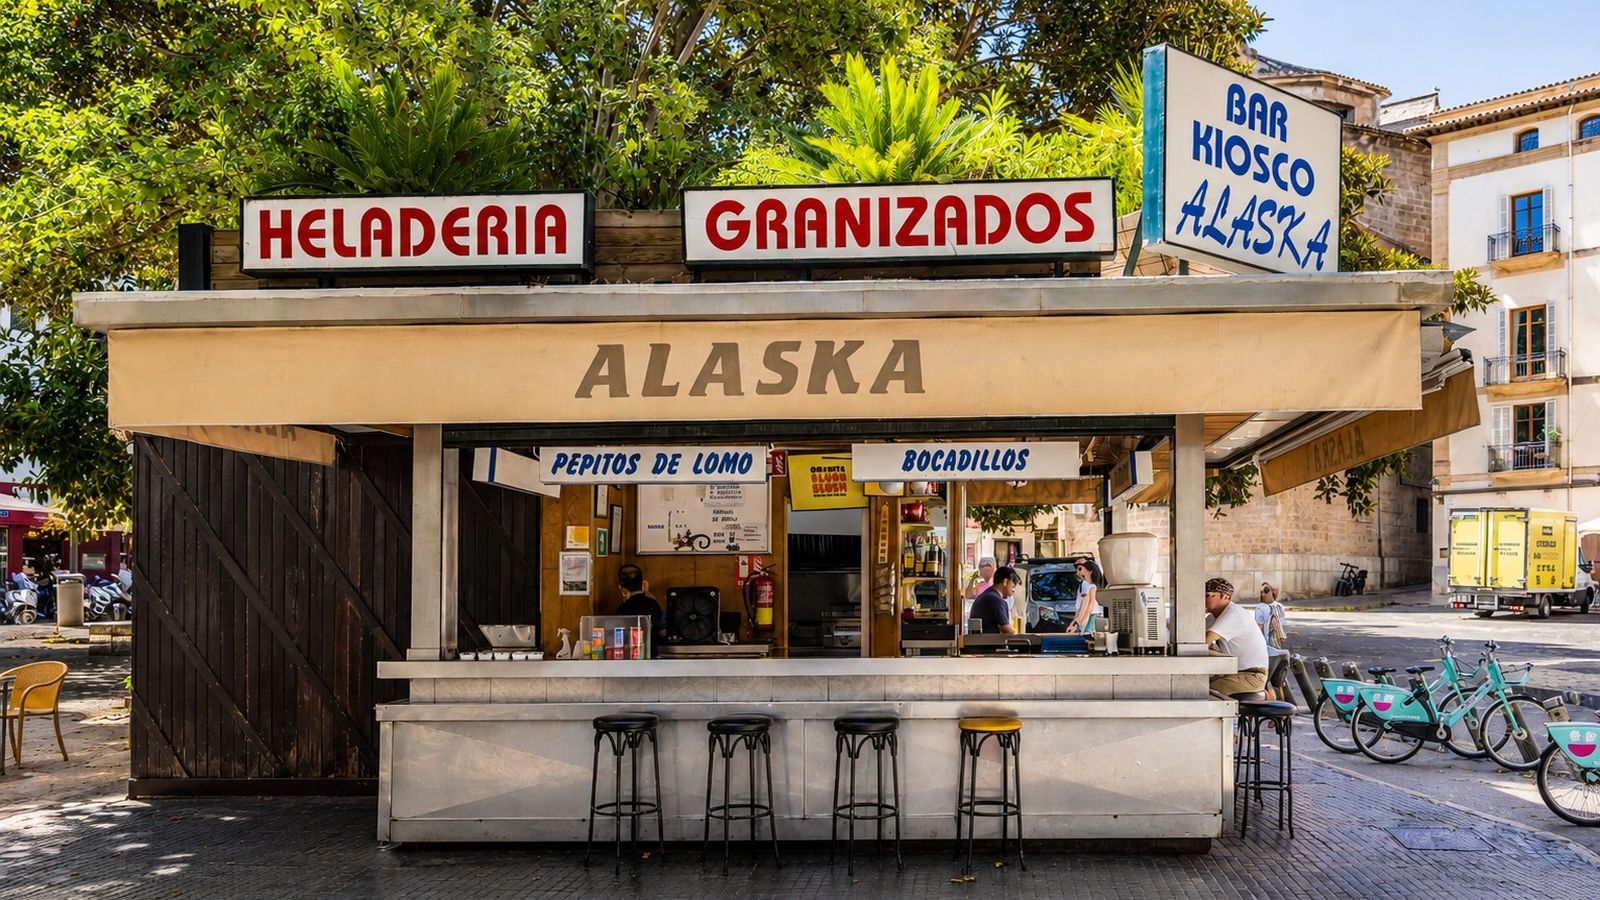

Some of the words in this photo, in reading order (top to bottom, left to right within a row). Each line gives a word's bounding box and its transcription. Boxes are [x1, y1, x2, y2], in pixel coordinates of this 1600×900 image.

[1226, 83, 1288, 143] BAR
[1192, 119, 1315, 197] KIOSCO
[258, 203, 568, 260] HELADERIA
[705, 191, 1095, 252] GRANIZADOS
[1175, 179, 1332, 272] ALASKA
[574, 339, 926, 399] ALASKA
[551, 452, 641, 476] PEPITOS
[652, 452, 682, 476] DE
[692, 451, 754, 476] LOMO
[902, 448, 1031, 472] BOCADILLOS
